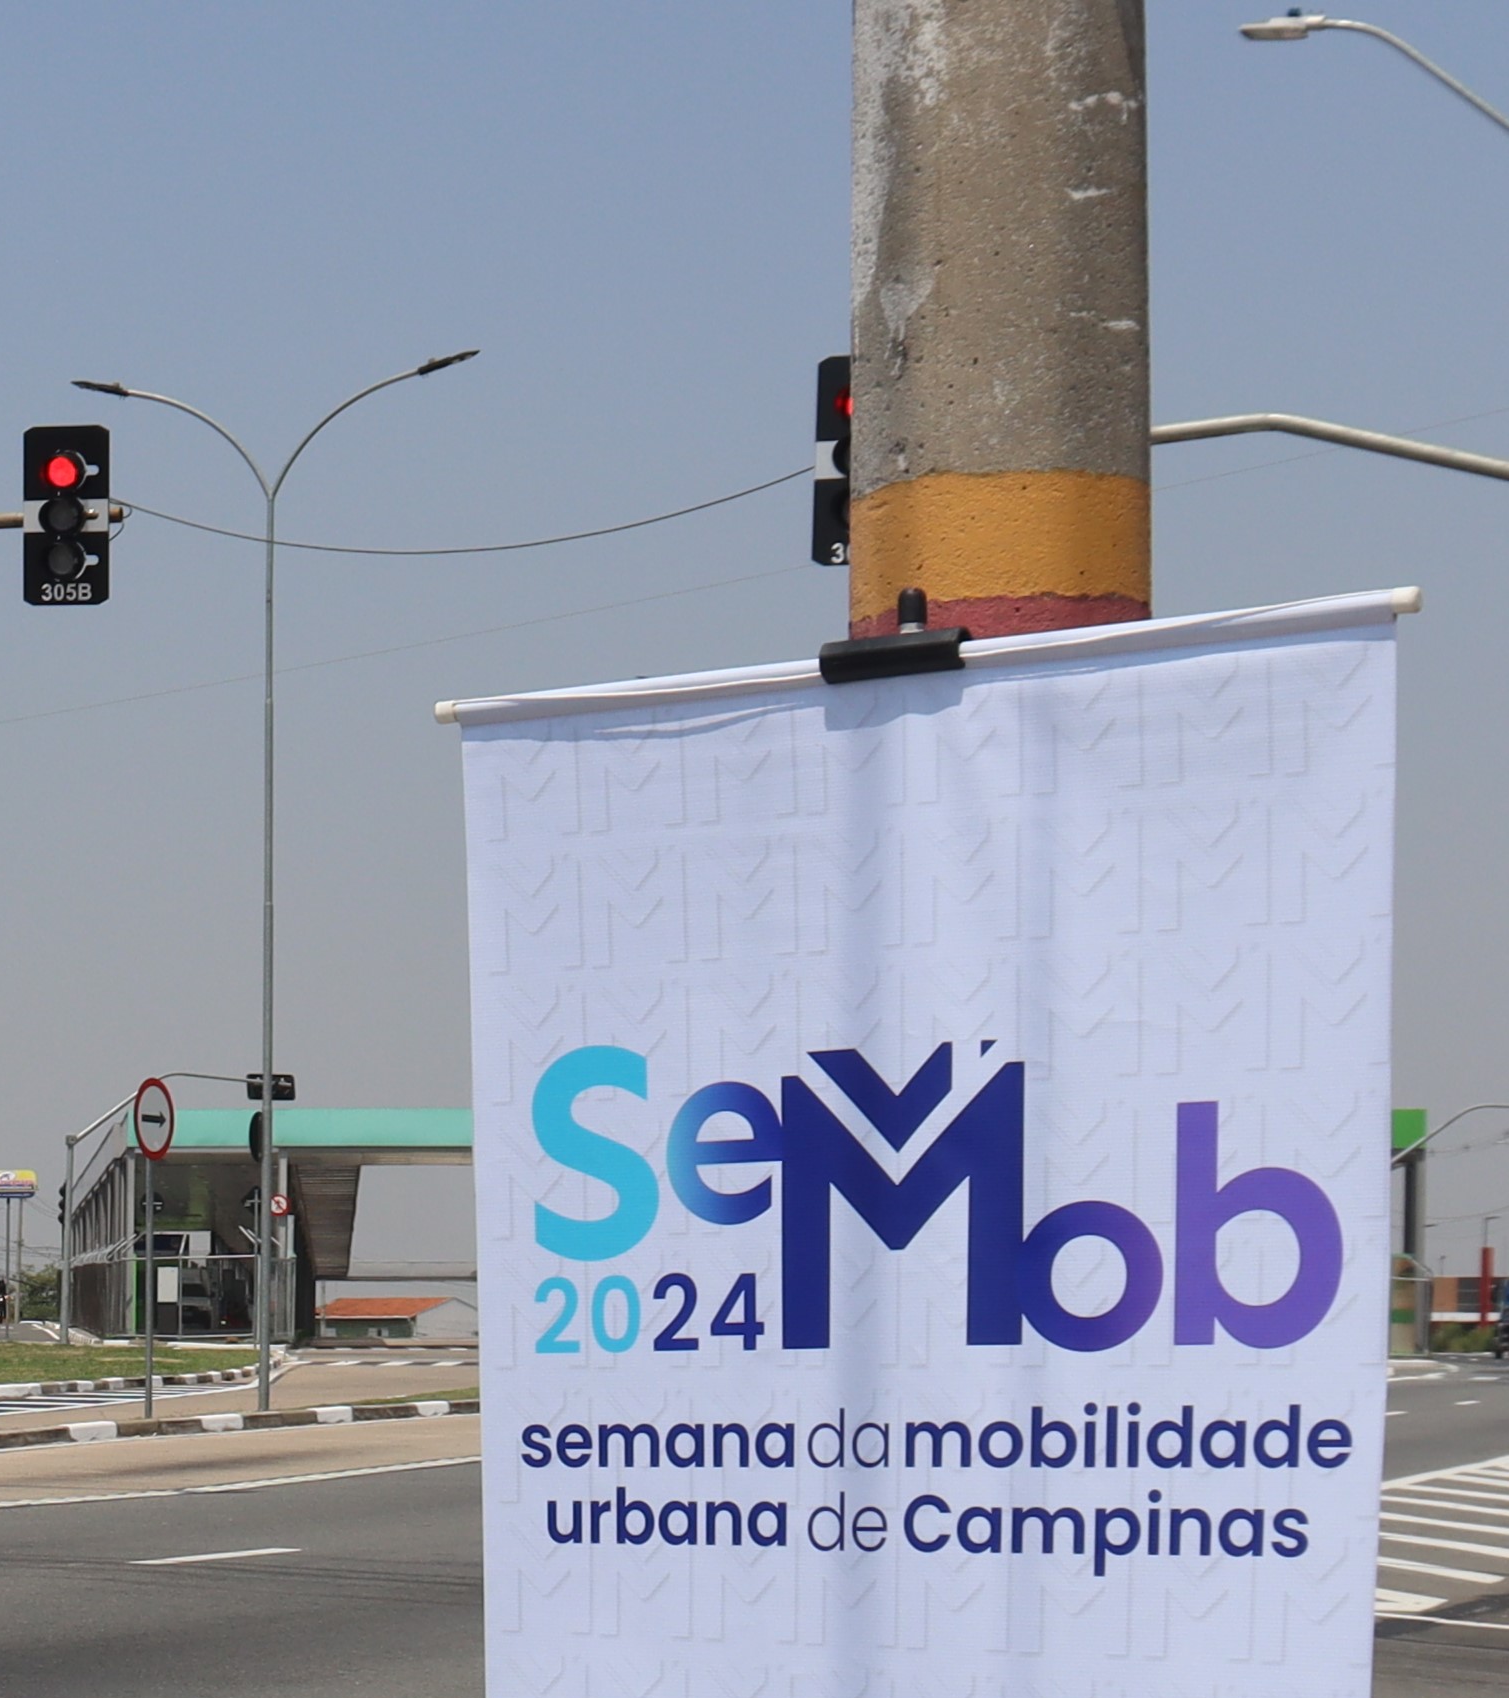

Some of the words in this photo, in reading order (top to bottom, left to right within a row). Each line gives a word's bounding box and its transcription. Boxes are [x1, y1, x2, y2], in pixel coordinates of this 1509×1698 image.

[830, 542, 850, 564] 3
[41, 583, 92, 602] 305B
[535, 1273, 764, 1353] 2024
[522, 1423, 794, 1468] semana
[808, 1408, 889, 1468] da
[905, 1402, 1352, 1469] mobilidade
[547, 1487, 787, 1547] urbana
[808, 1491, 887, 1552] de
[904, 1490, 1308, 1576] Campinas
